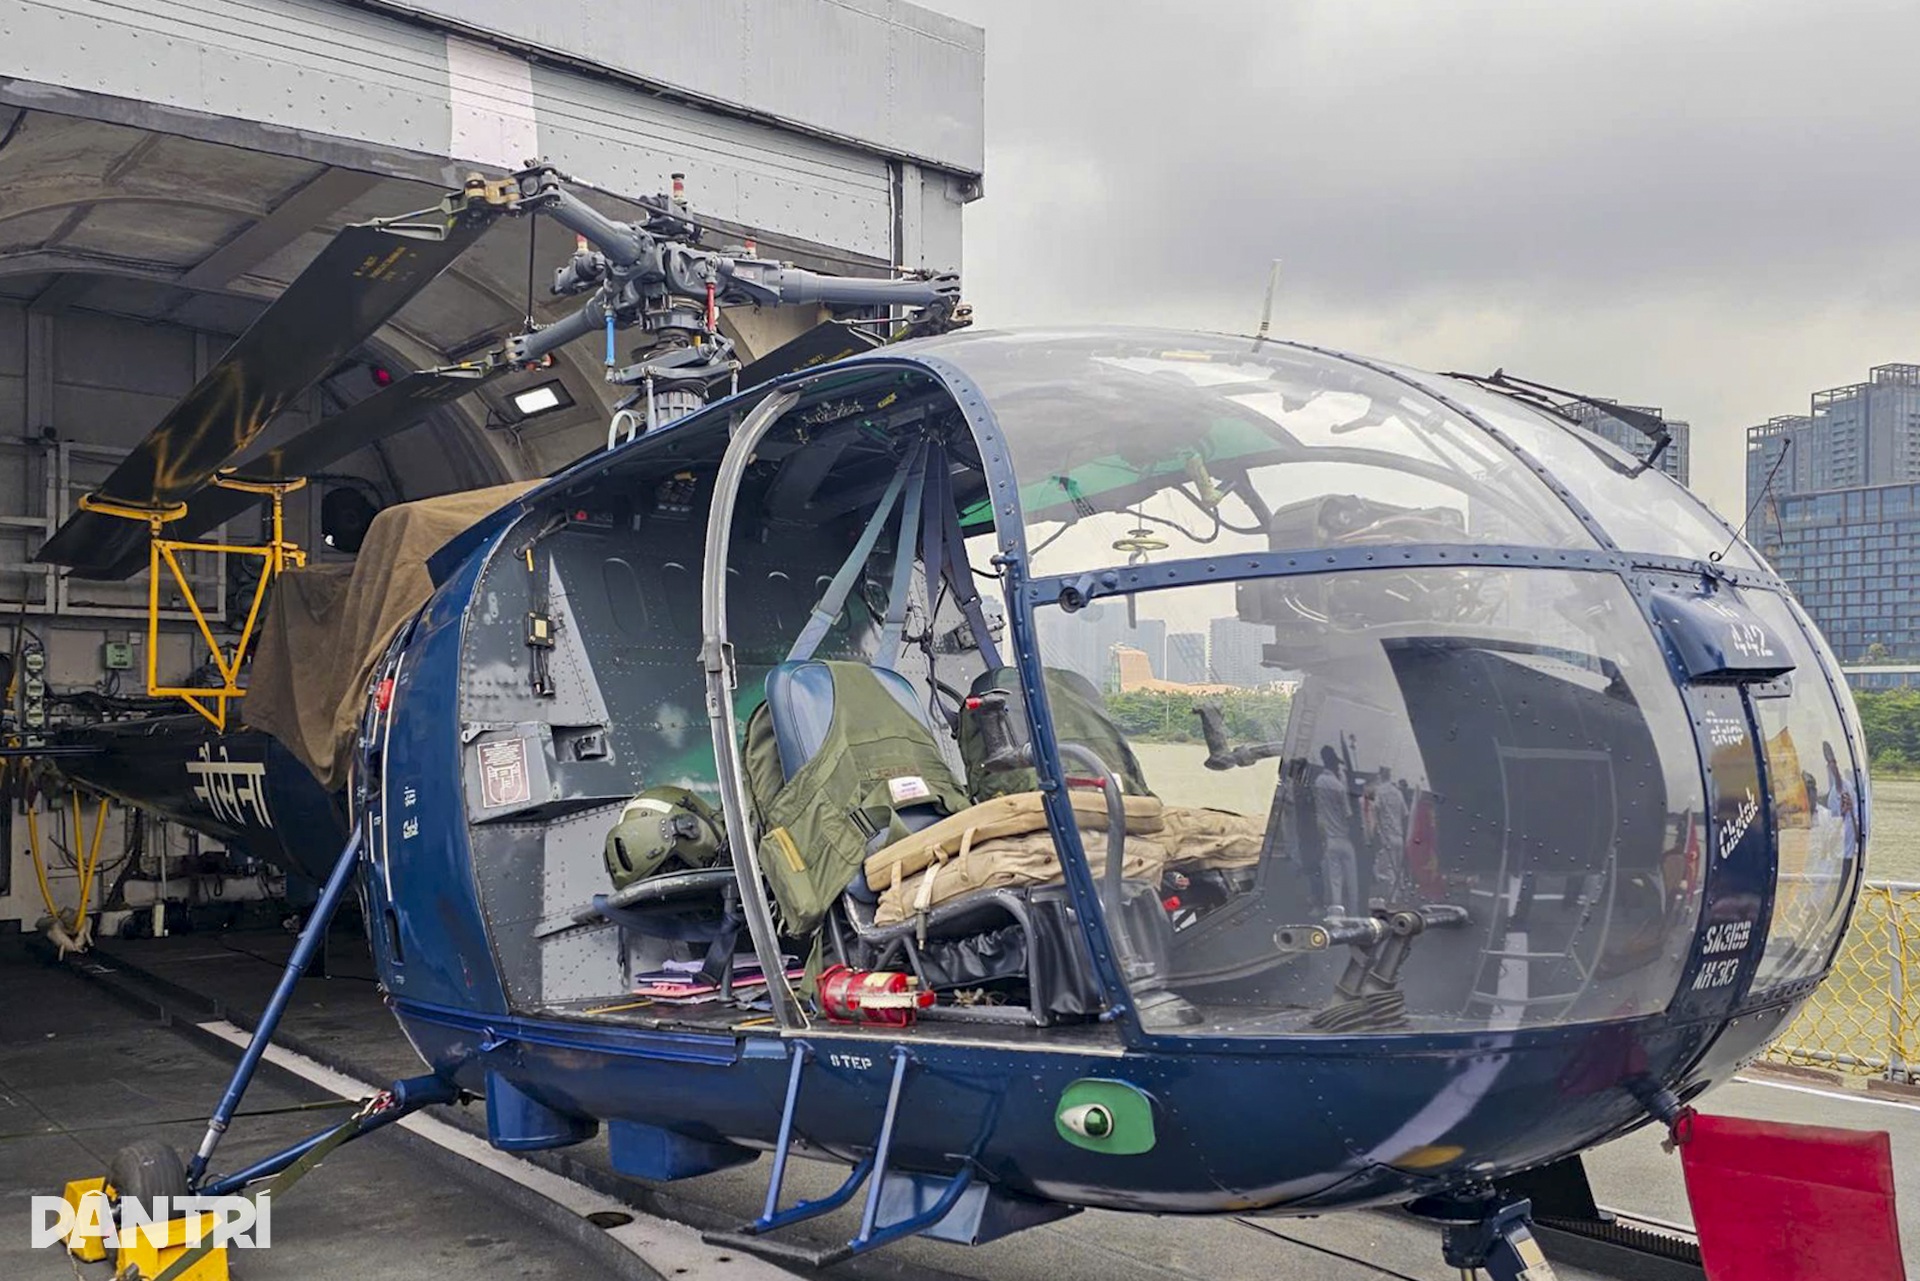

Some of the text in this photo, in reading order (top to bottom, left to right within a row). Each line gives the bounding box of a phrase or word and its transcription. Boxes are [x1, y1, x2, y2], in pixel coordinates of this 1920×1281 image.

[1730, 623, 1774, 657] 442
[185, 741, 274, 830] नौसेना
[830, 1053, 873, 1070] STEP
